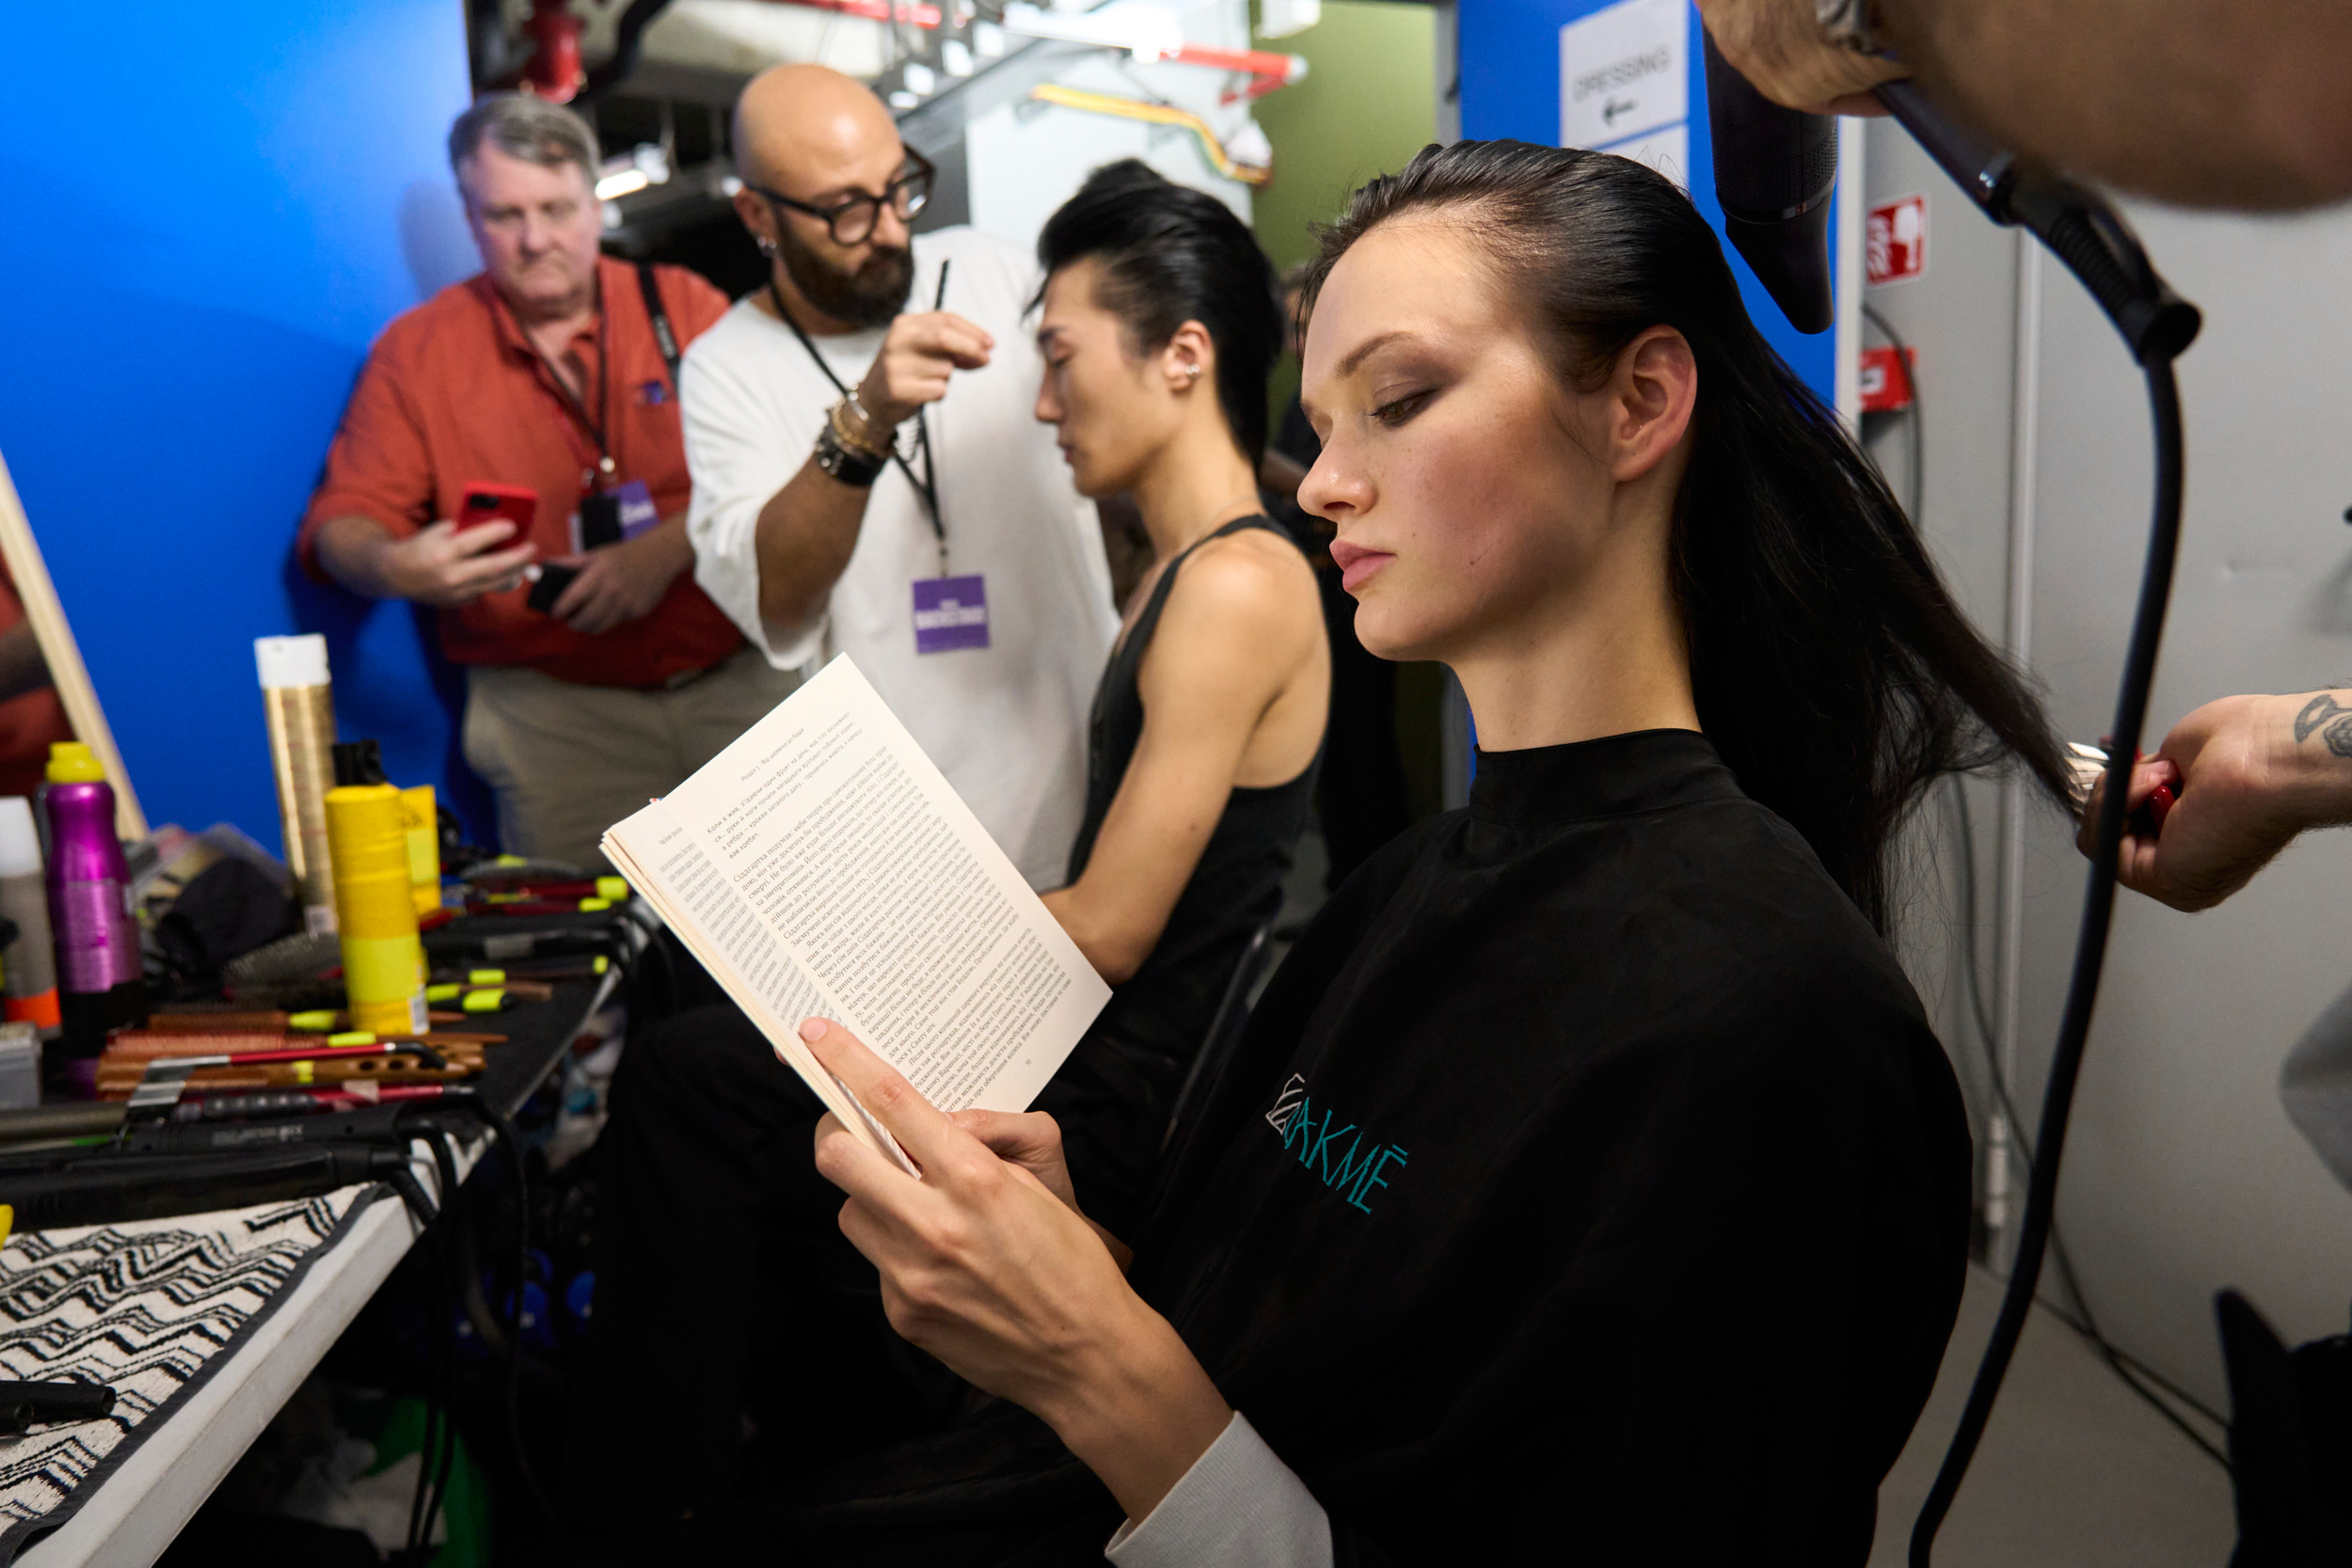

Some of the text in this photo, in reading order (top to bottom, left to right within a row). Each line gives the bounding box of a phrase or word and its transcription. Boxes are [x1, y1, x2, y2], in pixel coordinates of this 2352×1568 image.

[1573, 44, 1671, 102] DRESSING
[732, 853, 768, 884] Сіддгартха
[755, 866, 769, 879] він
[766, 857, 780, 871] уже
[779, 858, 795, 872] було
[761, 893, 787, 915] чоловік
[770, 901, 794, 925] дійшов
[785, 895, 818, 925] наблизили
[783, 910, 817, 940] Сіддгартха
[789, 917, 822, 948] Засмучені
[820, 902, 840, 922] аскети
[805, 931, 825, 948] Якось
[823, 922, 834, 933] він
[832, 914, 842, 925] сів
[827, 927, 845, 943] зійде
[812, 953, 833, 972] навіть
[817, 961, 837, 978] Через
[835, 953, 848, 964] сім
[845, 942, 859, 957] днів
[825, 958, 856, 988] позбутися
[854, 947, 867, 961] всіх
[833, 975, 853, 996] жання
[851, 949, 881, 977] позбутися
[853, 974, 869, 990] поки
[862, 995, 878, 1011] коли
[866, 1008, 892, 1035] карнації
[889, 994, 907, 1012] більш
[860, 1012, 876, 1027] було
[881, 1036, 896, 1052] леса
[894, 1014, 916, 1037] сансари
[887, 1045, 900, 1059] для
[914, 1014, 930, 1030] Саме
[894, 1051, 909, 1067] лося
[910, 1031, 928, 1049] Святу
[908, 1048, 925, 1066] Після
[923, 1033, 940, 1051] цього
[908, 1066, 923, 1082] яких
[920, 1055, 931, 1068] так
[939, 1050, 951, 1062] Він
[973, 1085, 985, 1099] про
